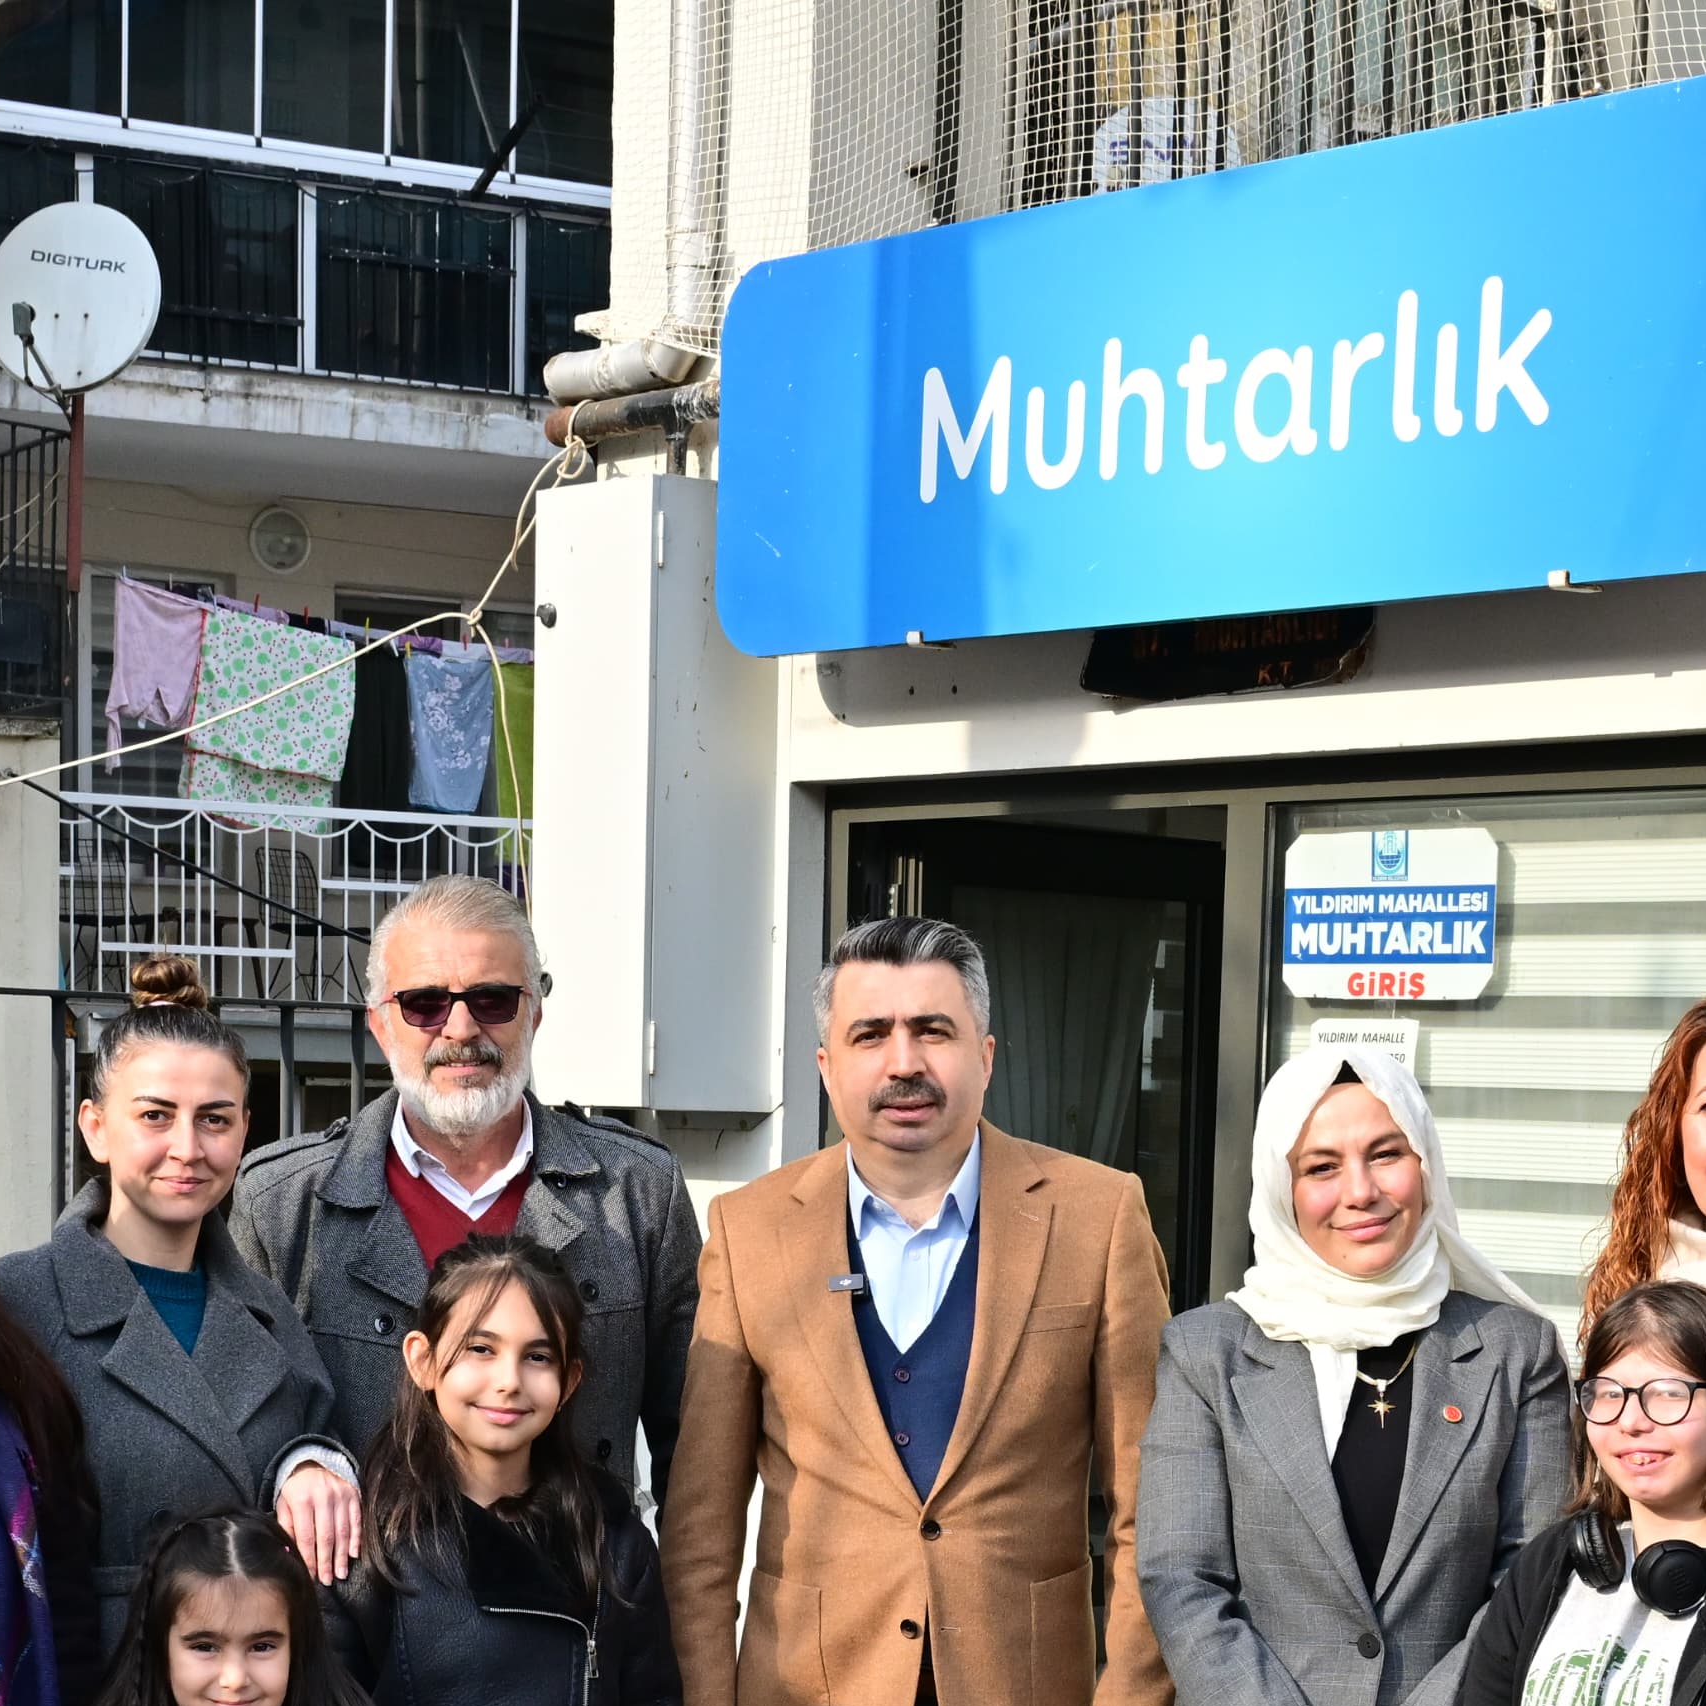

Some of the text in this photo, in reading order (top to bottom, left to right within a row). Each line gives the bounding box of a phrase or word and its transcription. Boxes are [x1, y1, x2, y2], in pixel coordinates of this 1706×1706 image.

[30, 249, 126, 273] DIGITURK
[919, 275, 1553, 504] Muhtarlık
[1292, 895, 1374, 914] YILDIRIM
[1291, 920, 1487, 955] MUHTARLIK
[1317, 1032, 1405, 1044] YILDIRIM MAHALLE
